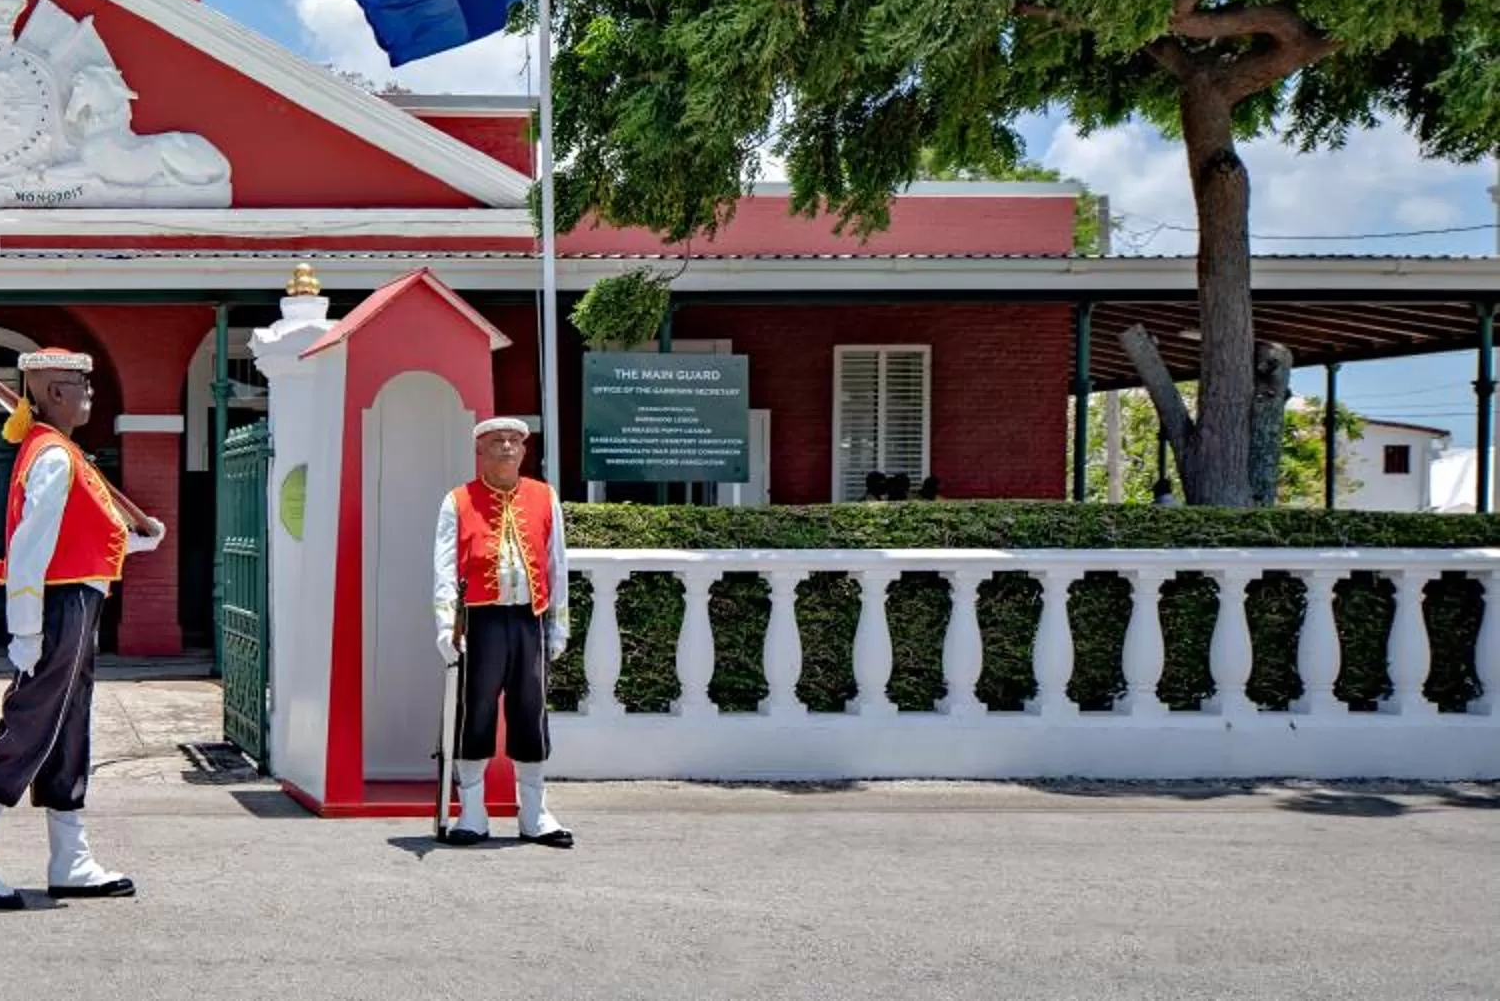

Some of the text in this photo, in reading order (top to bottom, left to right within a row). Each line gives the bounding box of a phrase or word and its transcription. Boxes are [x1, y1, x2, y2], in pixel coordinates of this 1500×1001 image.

[614, 369, 721, 381] THE MAIN GUARD
